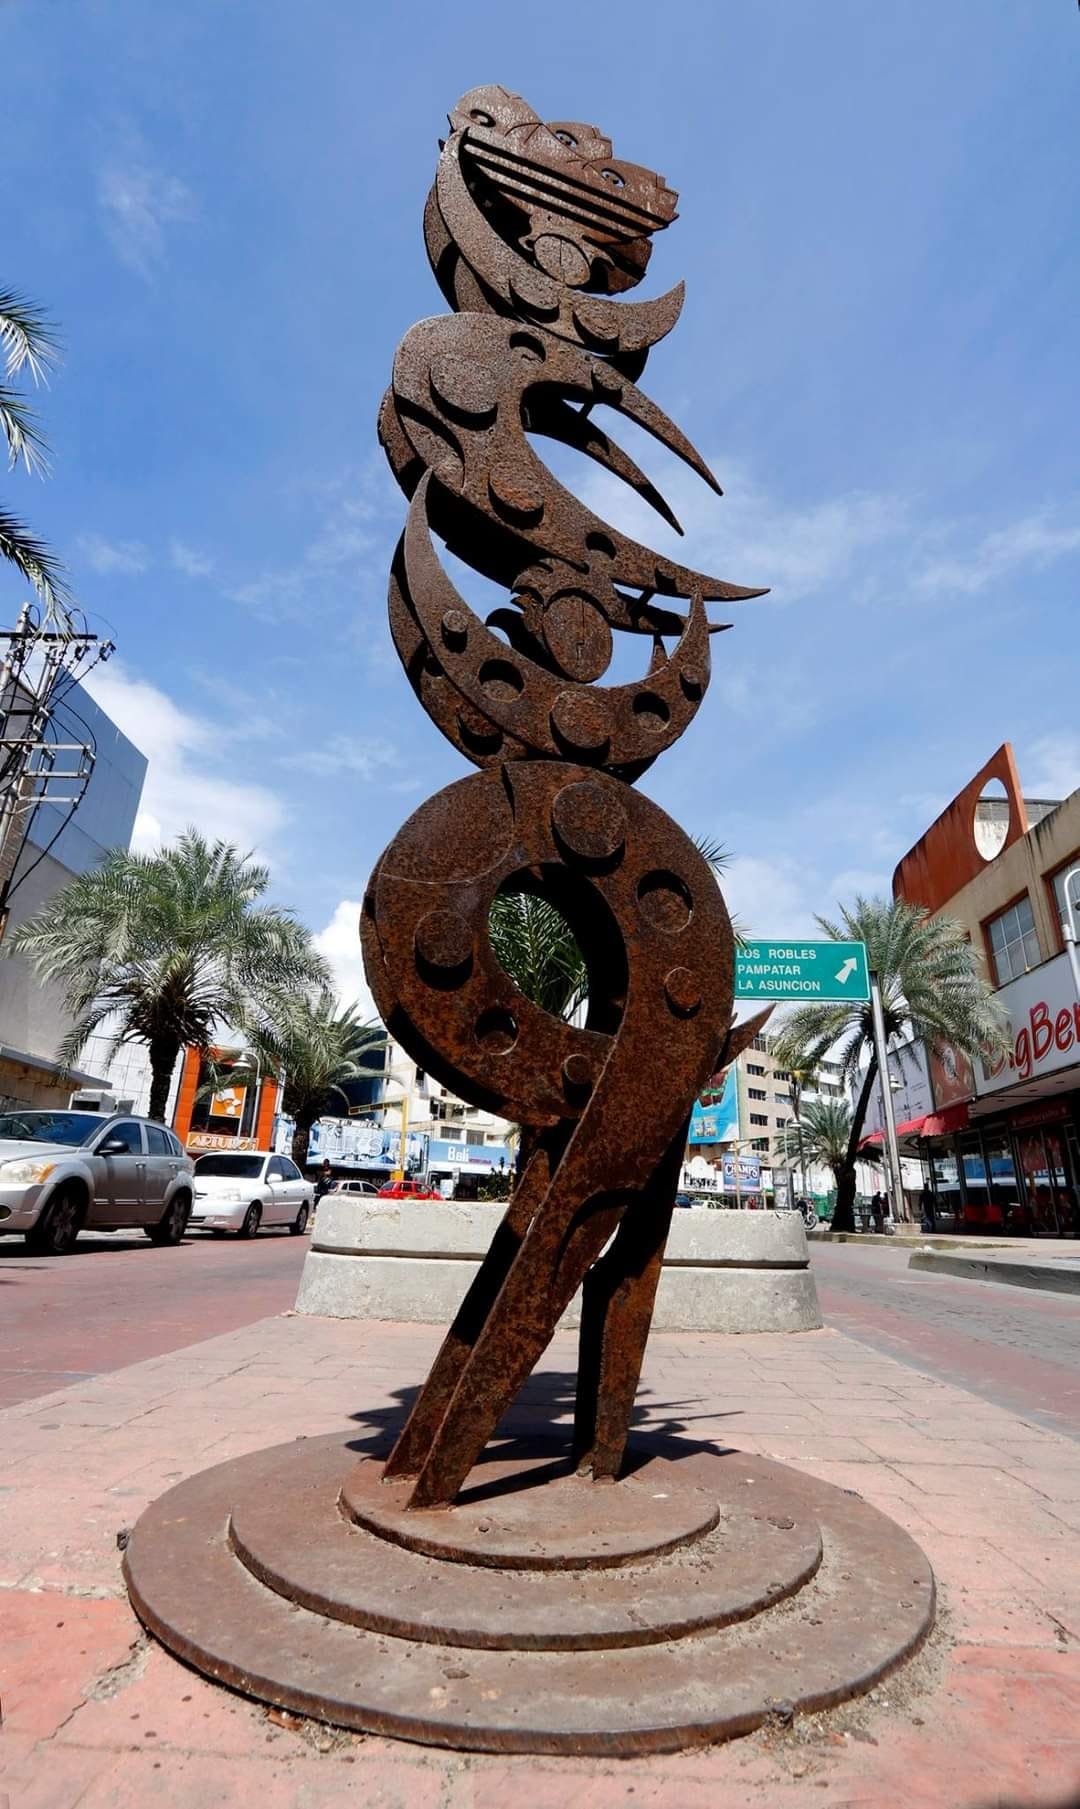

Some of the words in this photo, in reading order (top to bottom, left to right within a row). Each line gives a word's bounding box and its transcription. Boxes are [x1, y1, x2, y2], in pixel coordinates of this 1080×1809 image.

[736, 949, 760, 959] LOS
[768, 949, 816, 960] ROBLES
[738, 965, 801, 976] PAMPATAR
[738, 980, 754, 990] LA
[758, 980, 821, 992] ASUNCION
